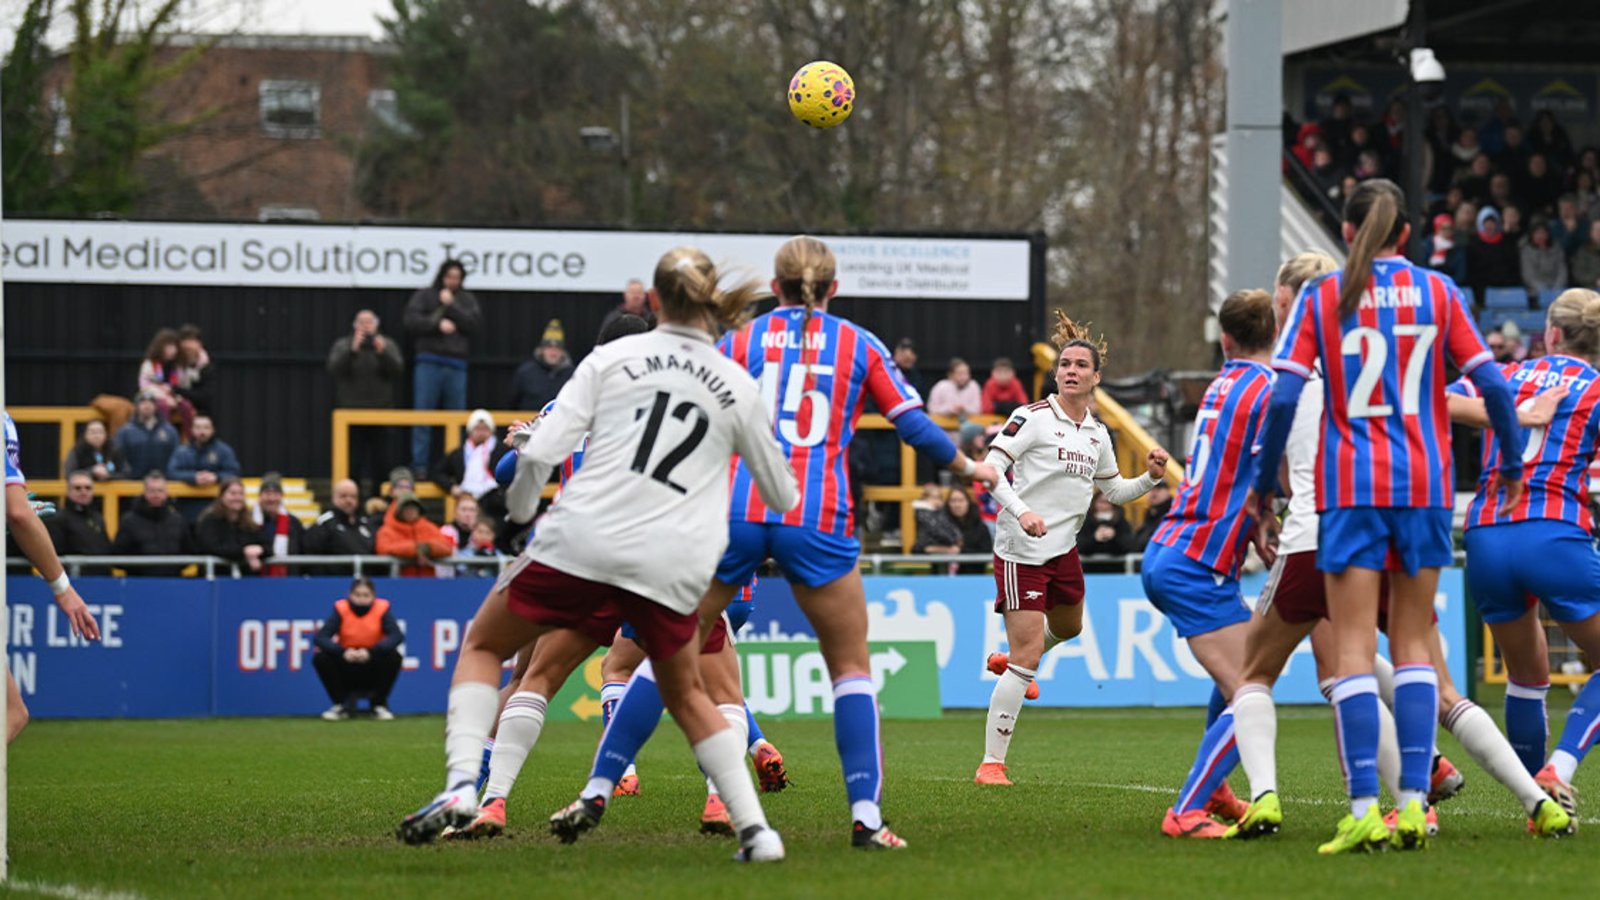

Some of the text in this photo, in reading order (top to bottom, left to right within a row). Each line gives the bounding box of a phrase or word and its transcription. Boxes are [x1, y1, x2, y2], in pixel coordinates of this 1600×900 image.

[62, 237, 228, 271] Medical
[241, 240, 429, 275] Solutions
[440, 243, 585, 277] Terrace
[916, 262, 969, 275] Medical
[1358, 285, 1422, 310] ARKIN
[761, 330, 827, 350] NOLAN
[622, 354, 736, 410] L.MAANUM
[1341, 324, 1439, 419] 27
[1514, 368, 1590, 391] EVERETT
[759, 361, 834, 448] 15
[630, 390, 710, 495] 12
[7, 604, 124, 648] R LE
[240, 618, 420, 670] OFFL
